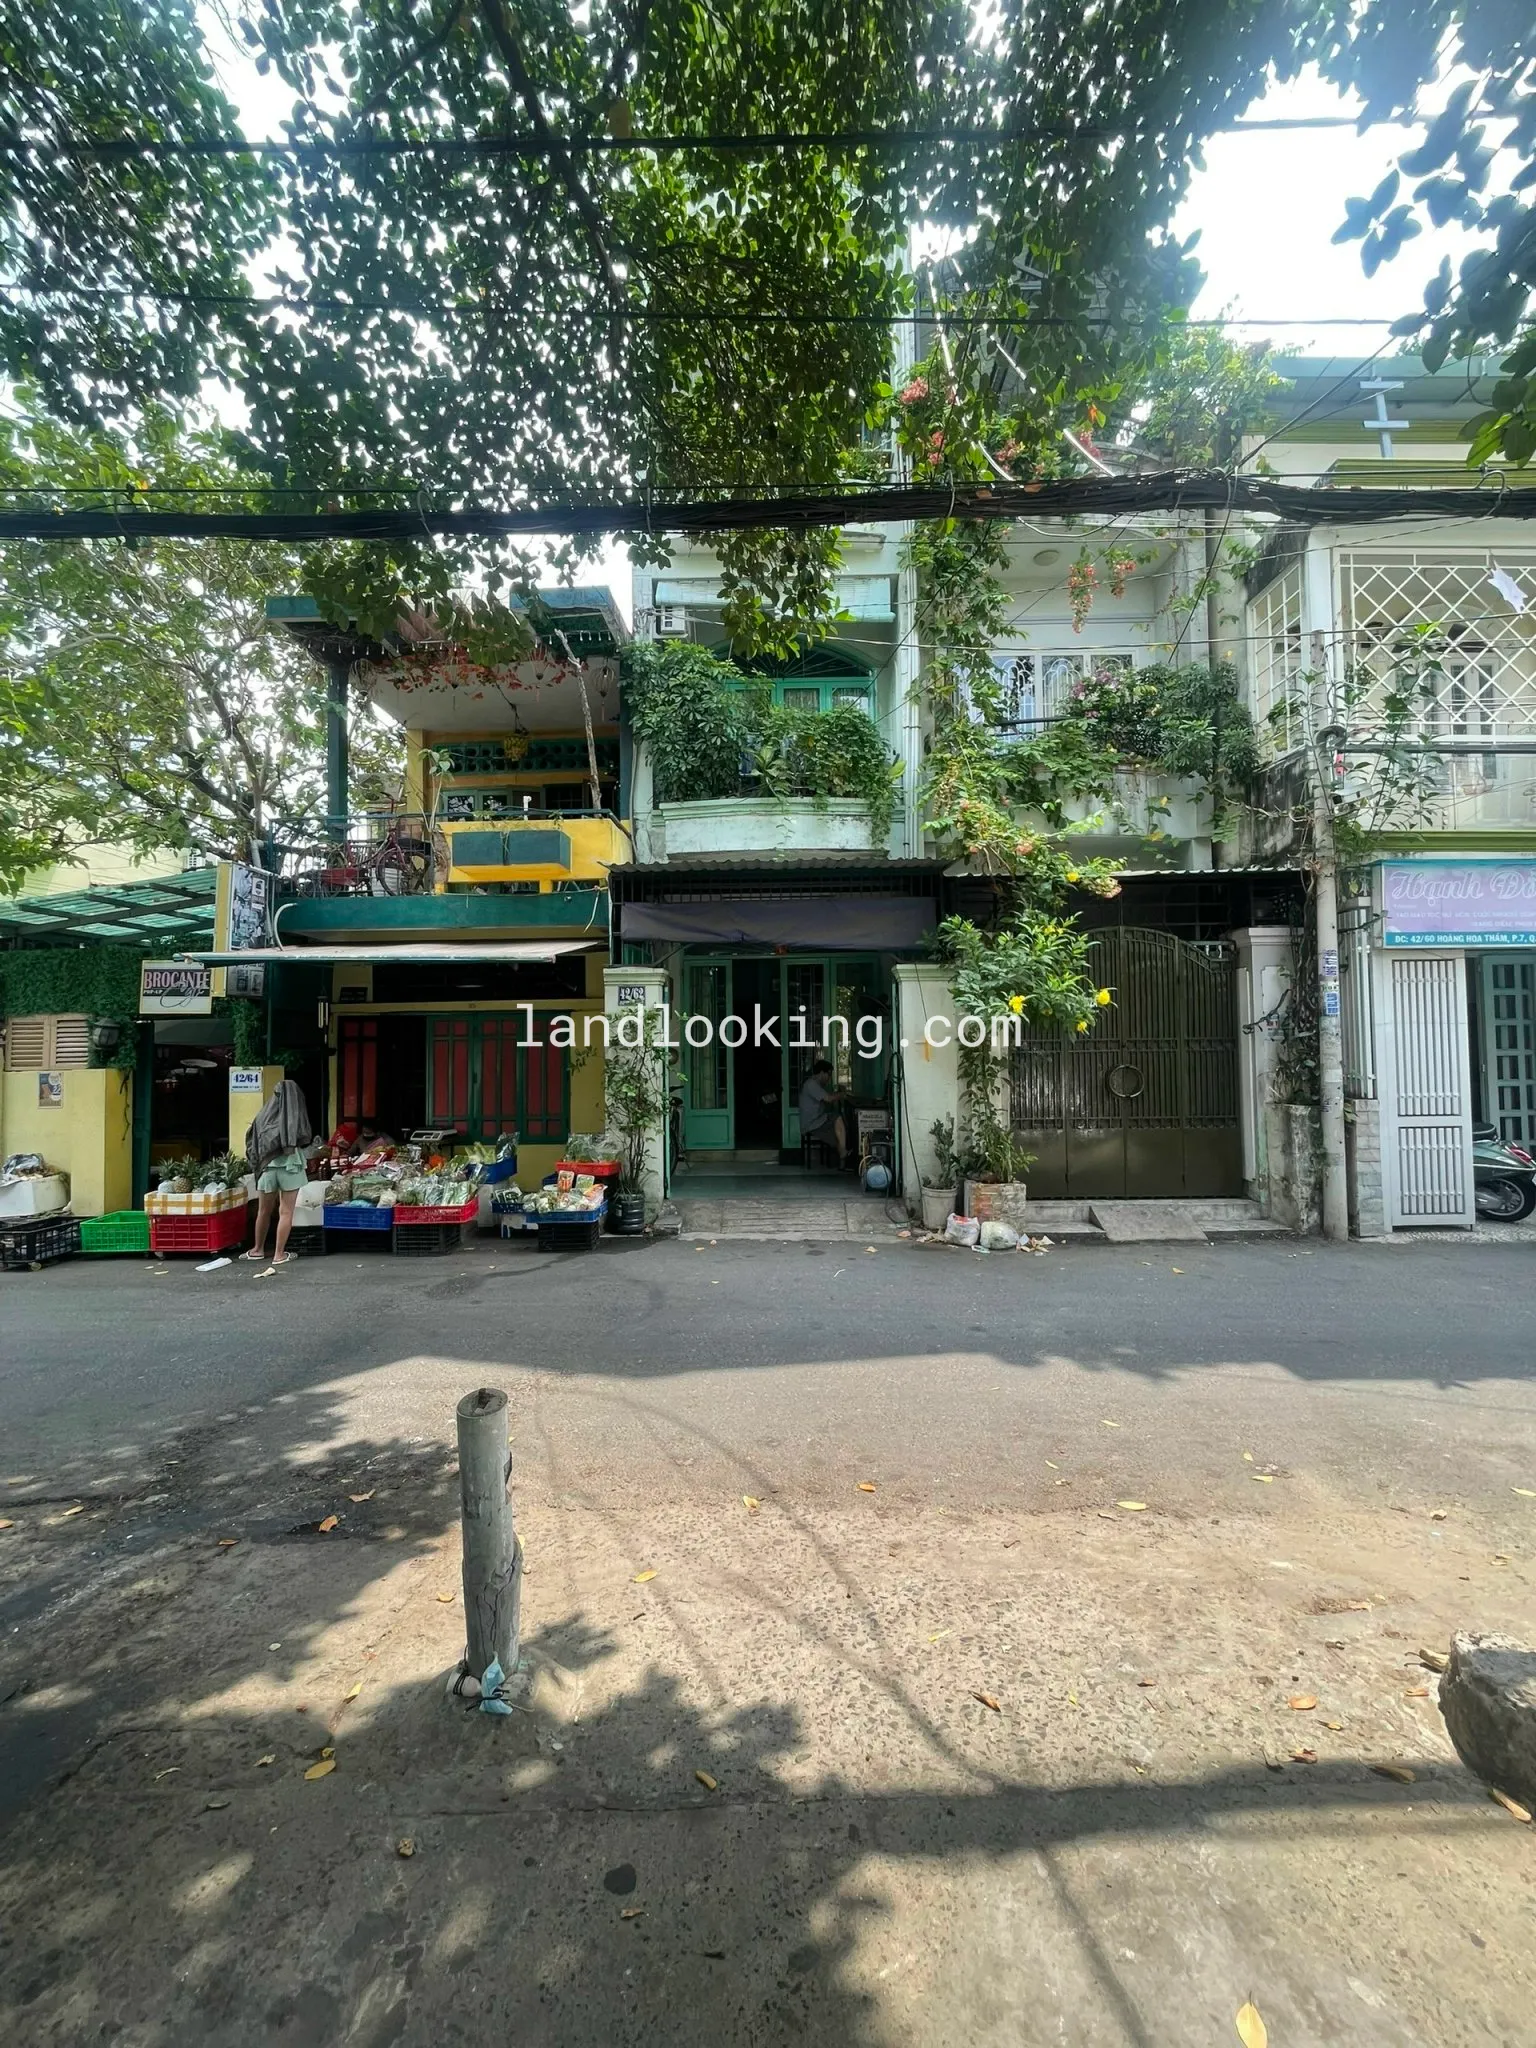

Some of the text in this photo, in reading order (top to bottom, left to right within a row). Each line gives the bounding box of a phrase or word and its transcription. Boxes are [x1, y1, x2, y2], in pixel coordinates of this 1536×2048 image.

[1410, 934, 1434, 943] 42/60
[1466, 934, 1482, 943] HOA
[144, 971, 210, 990] BROCANTE
[620, 987, 644, 1000] 42/62
